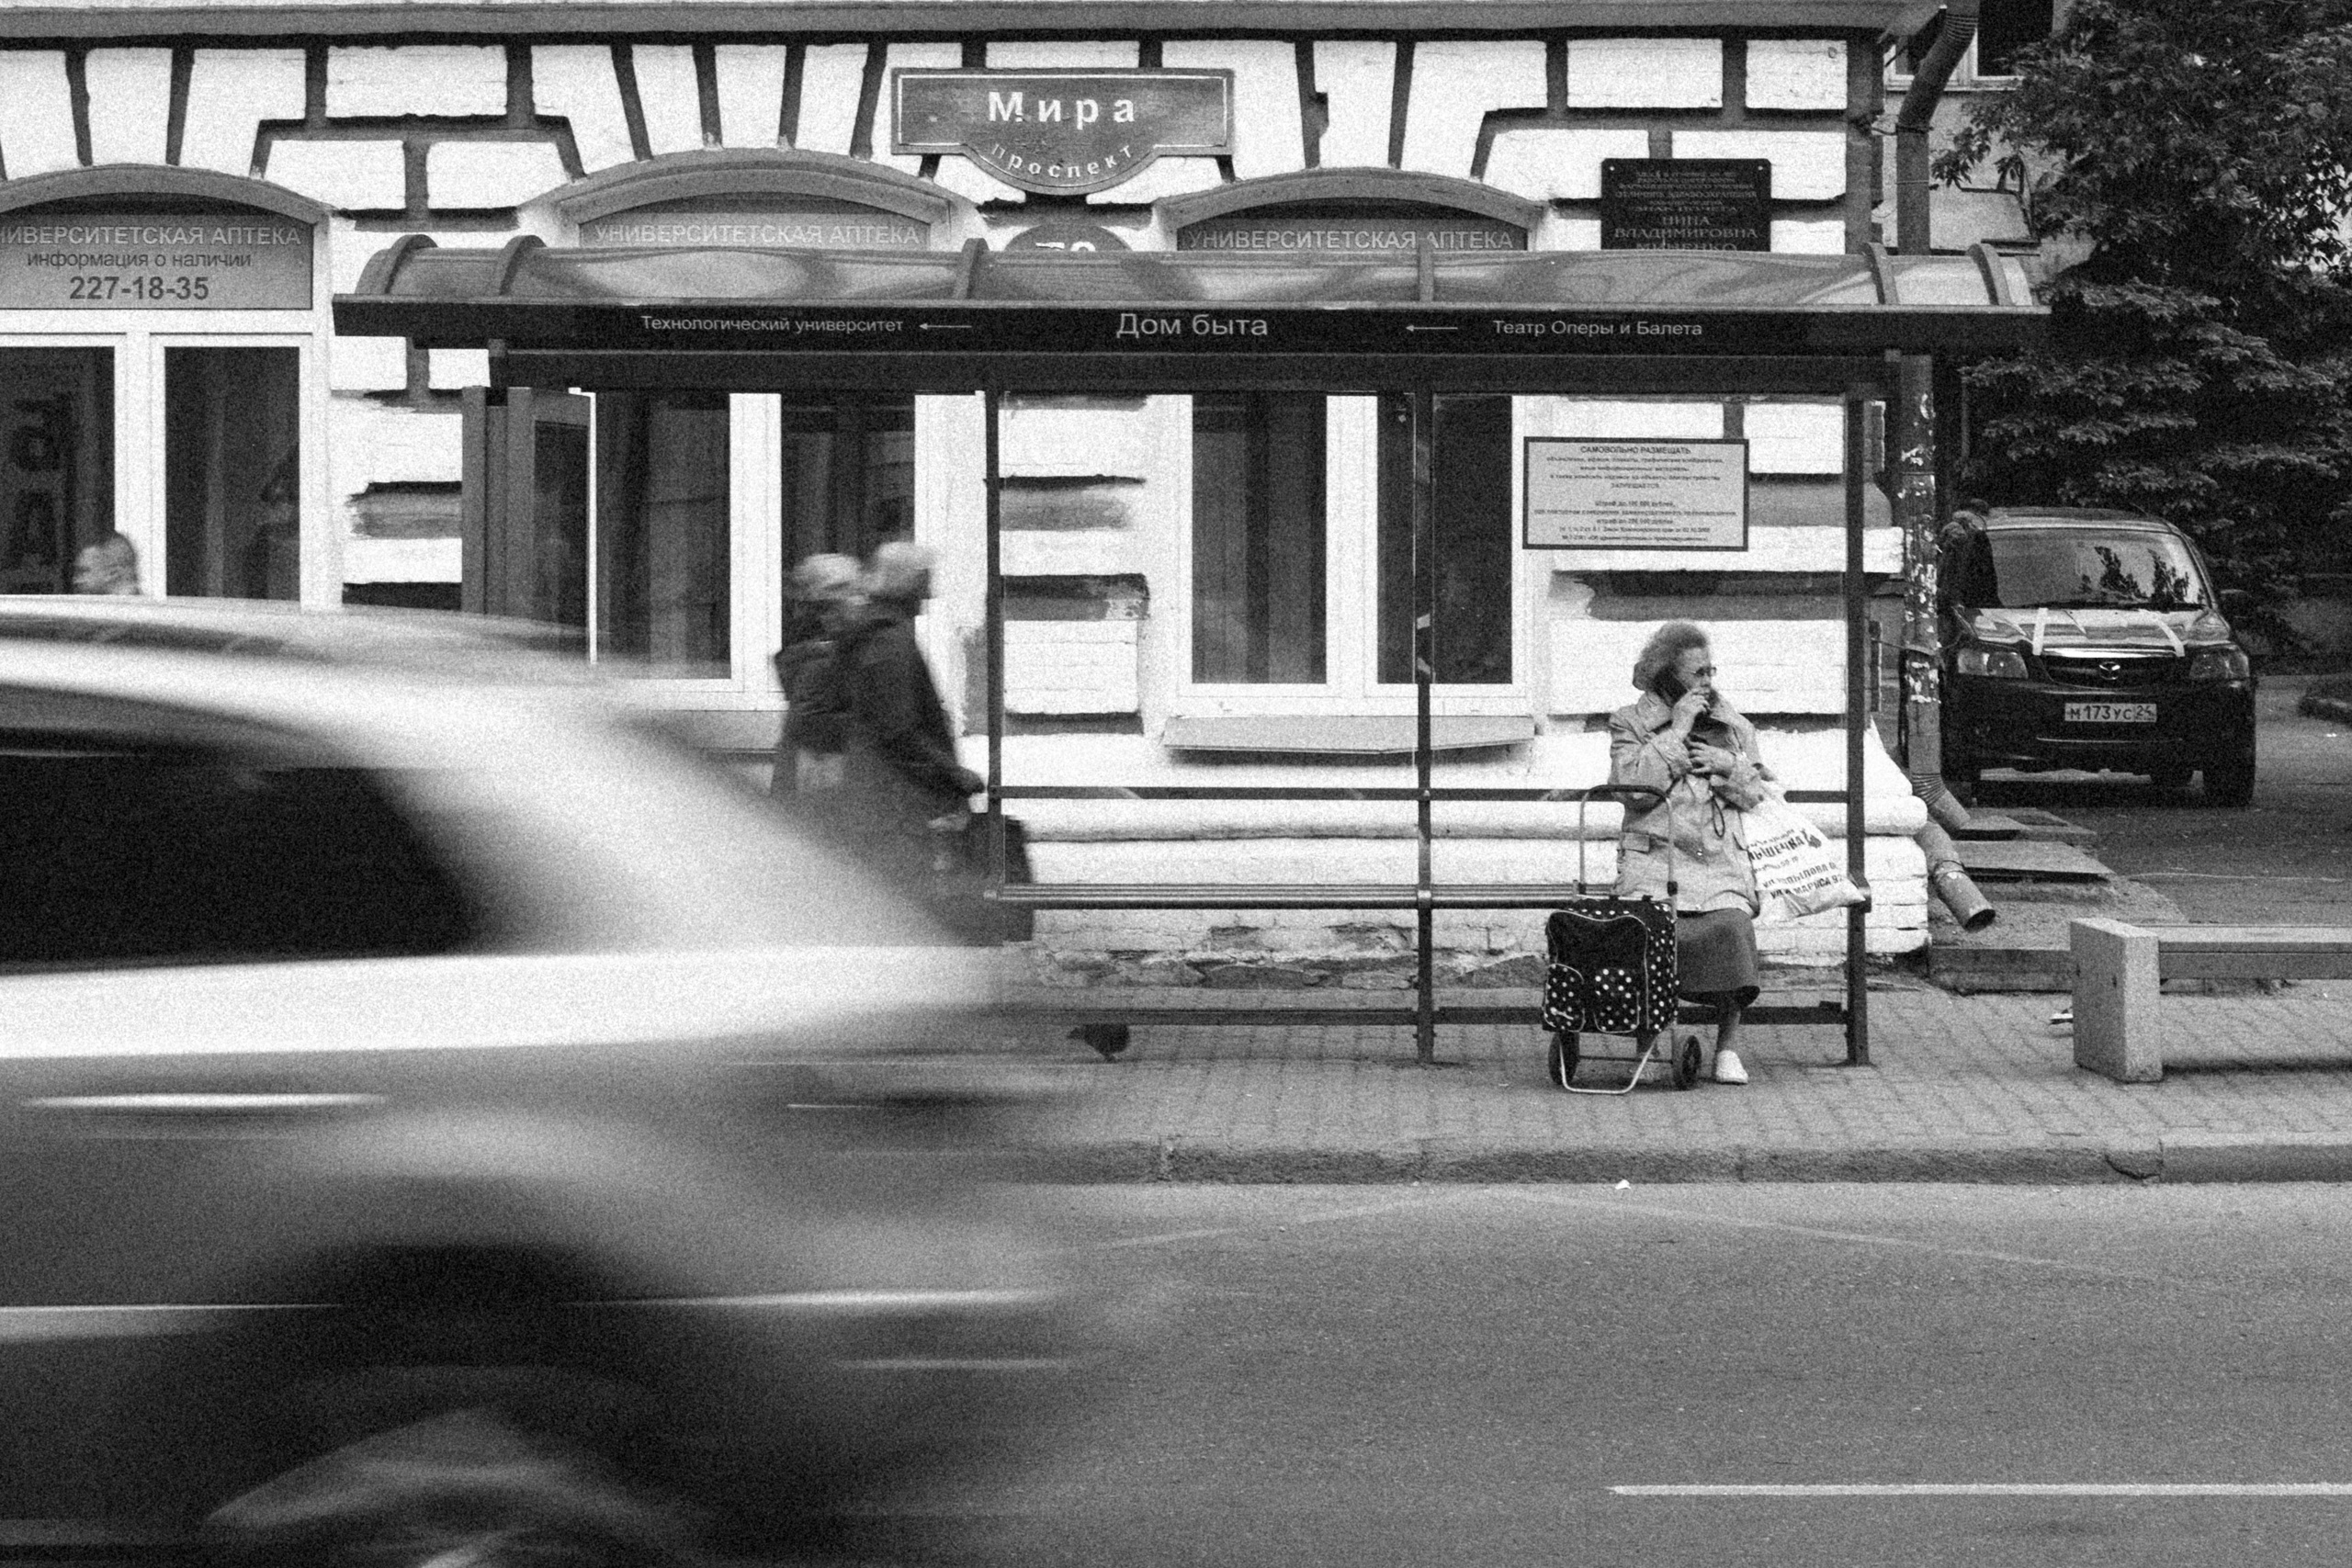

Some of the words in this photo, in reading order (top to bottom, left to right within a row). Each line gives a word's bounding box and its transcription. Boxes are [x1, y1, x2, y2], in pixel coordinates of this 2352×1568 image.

[988, 90, 1136, 130] Мира
[991, 141, 1134, 179] проспект
[210, 226, 302, 245] АПТЕКА
[594, 225, 822, 244] УНИВЕРСИТЕТСКАЯ
[830, 225, 921, 245] АПТЕКА
[1187, 231, 1416, 249] УНИВЕРСИТЕТСКАЯ
[1420, 231, 1513, 249] АПТЕКА
[28, 251, 149, 269] информация
[154, 255, 166, 267] о
[173, 254, 252, 267] наличии
[69, 276, 210, 301] 227-18-35
[641, 315, 789, 332] Технологический
[796, 319, 904, 334] университет
[1116, 312, 1182, 338] Дом
[1193, 313, 1269, 336] быта
[1492, 320, 1545, 336] Театр
[1551, 321, 1614, 337] Оперы
[1620, 323, 1631, 335] и
[1636, 321, 1702, 336] Балета
[1580, 446, 1639, 454] САМОВОЛЬНО
